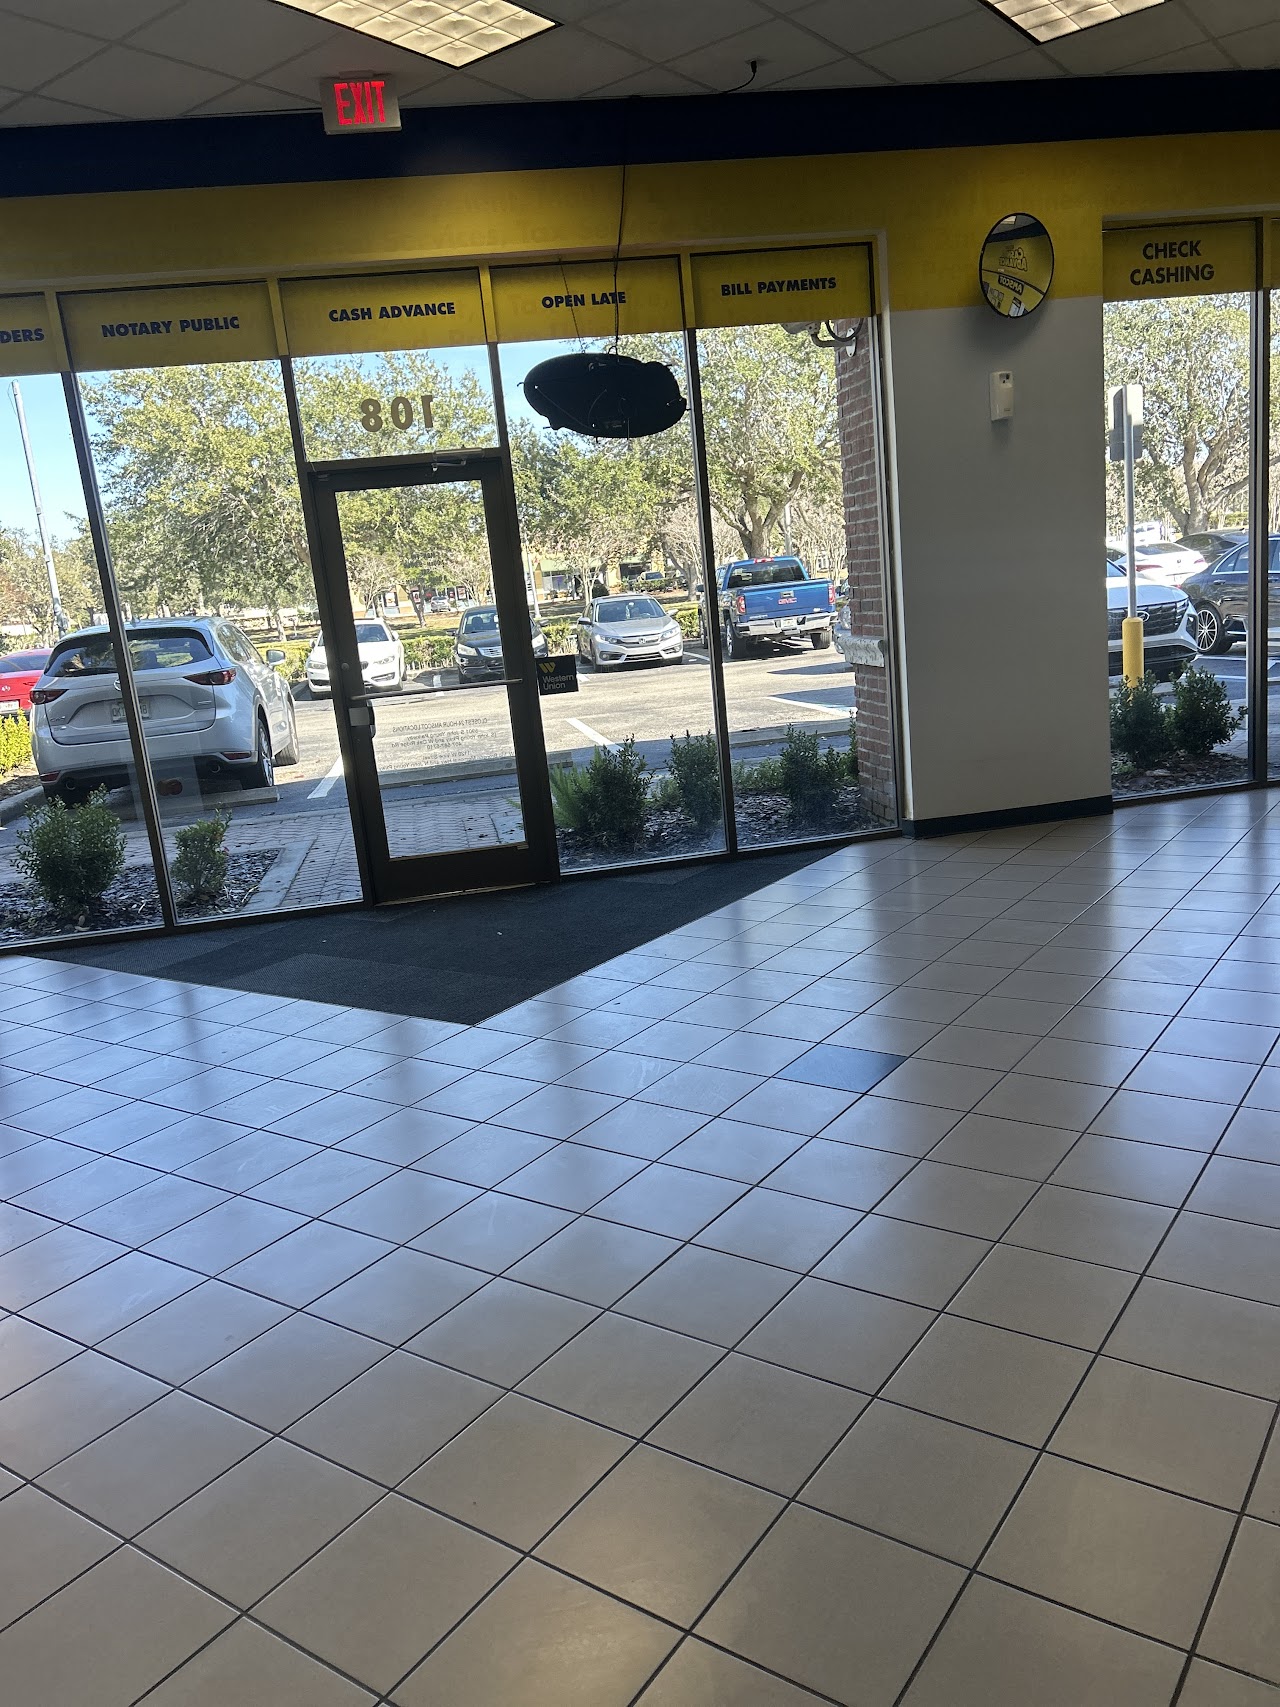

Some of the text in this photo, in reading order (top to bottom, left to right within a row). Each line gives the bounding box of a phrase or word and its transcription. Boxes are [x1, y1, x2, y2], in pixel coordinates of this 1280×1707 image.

[334, 81, 386, 125] EXIT
[1142, 240, 1202, 260] CHECK
[1130, 263, 1215, 286] CASHING
[721, 277, 837, 296] BILL PAYMENTS
[541, 291, 626, 309] OPEN LATE
[328, 302, 455, 322] CASH ADVANCE
[101, 316, 240, 338] NOTARY PUBLIC
[542, 674, 574, 683] Western
[543, 682, 566, 690] Union
